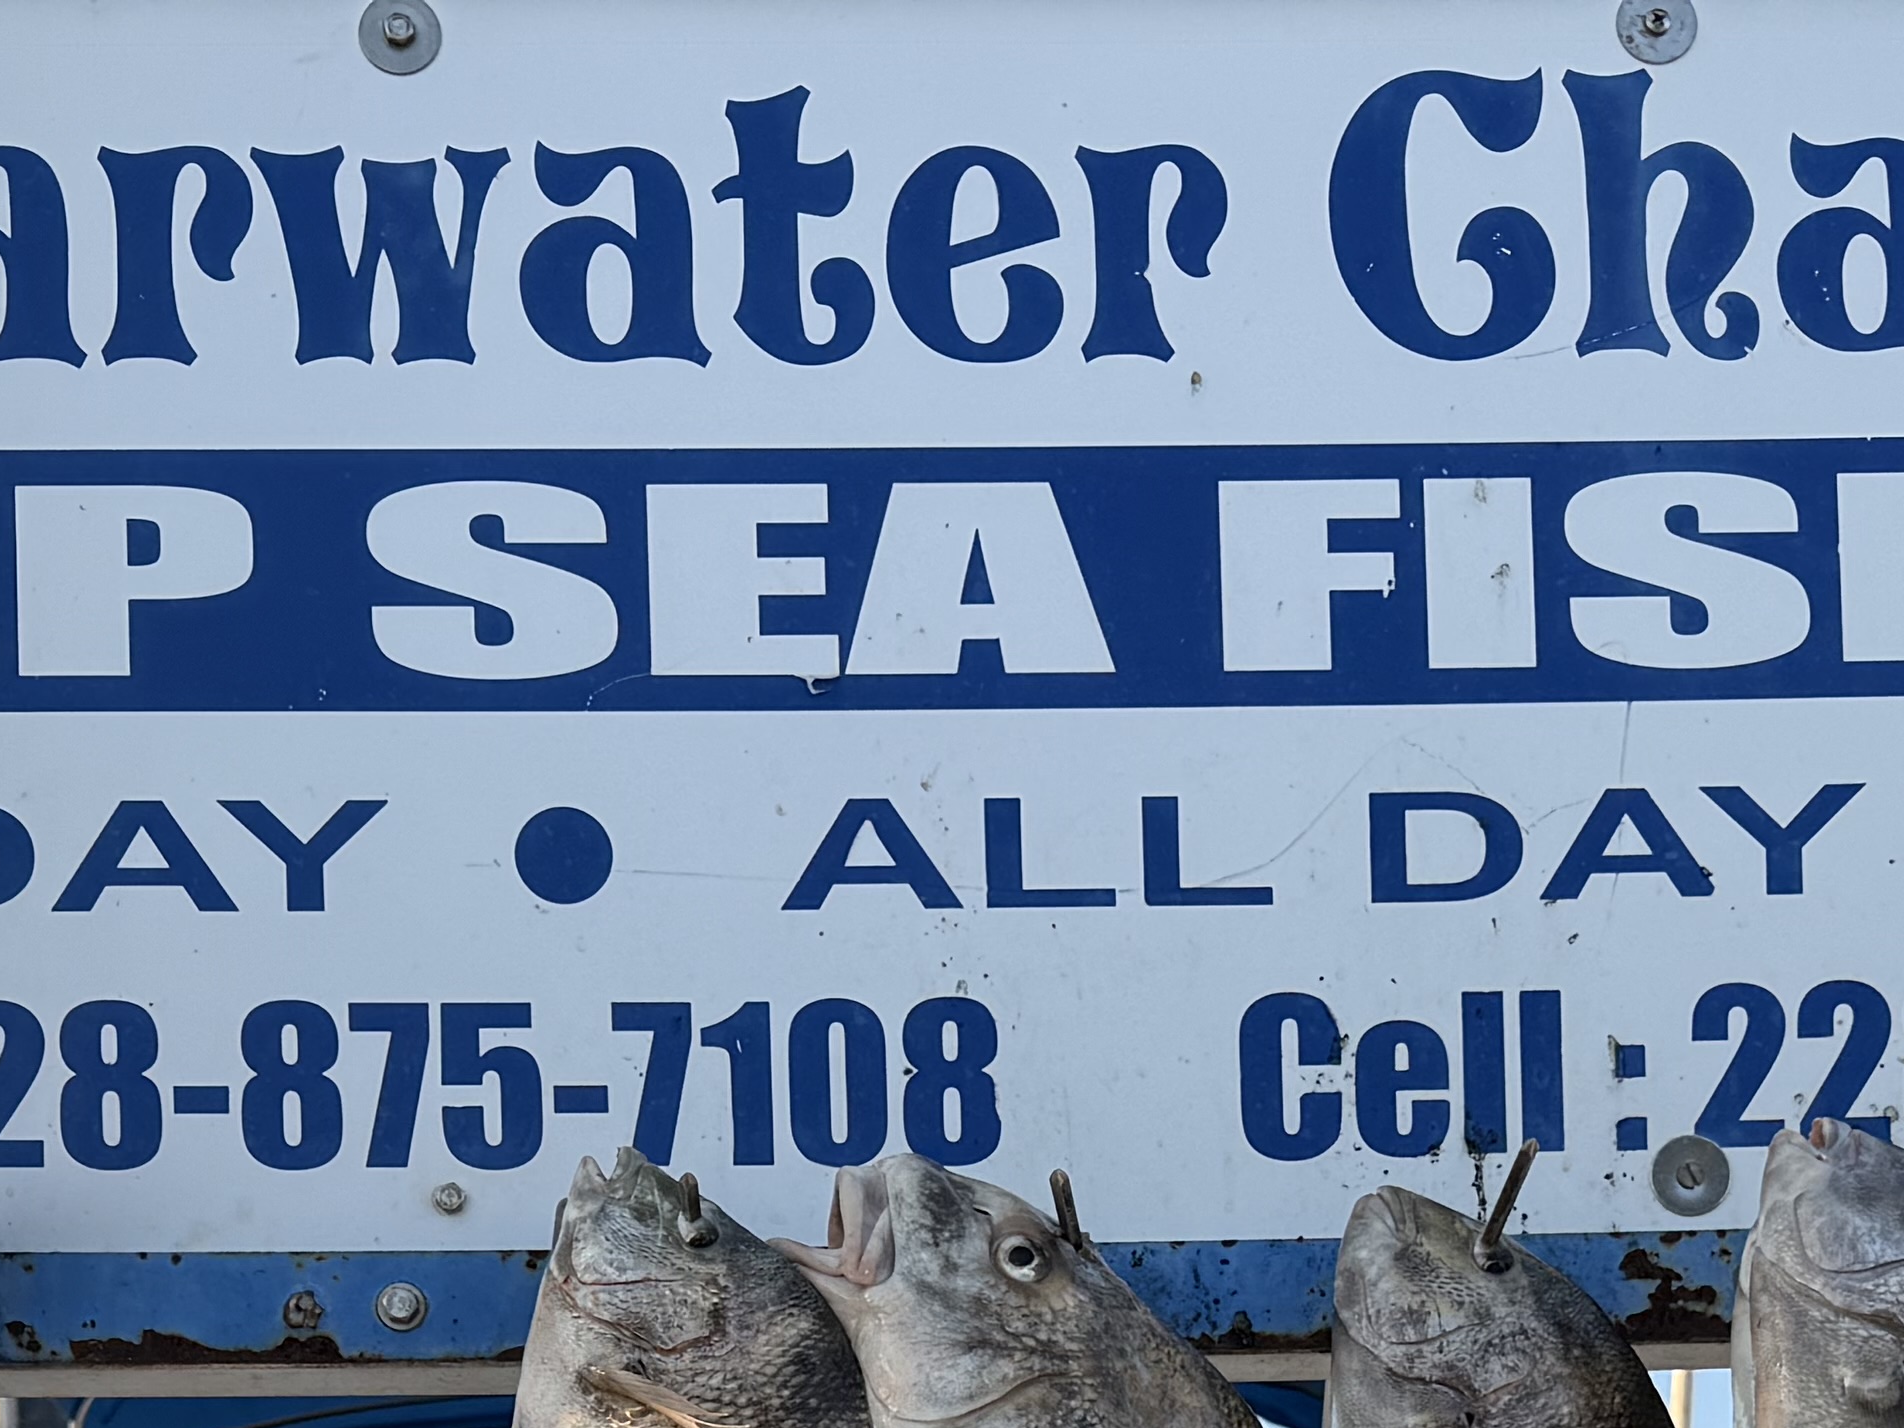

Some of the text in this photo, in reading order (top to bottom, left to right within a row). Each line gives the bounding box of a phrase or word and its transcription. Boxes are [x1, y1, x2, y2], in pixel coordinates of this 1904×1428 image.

[366, 481, 1116, 680] SEA
[781, 796, 1274, 911] ALL
[1369, 783, 1867, 904] DAY
